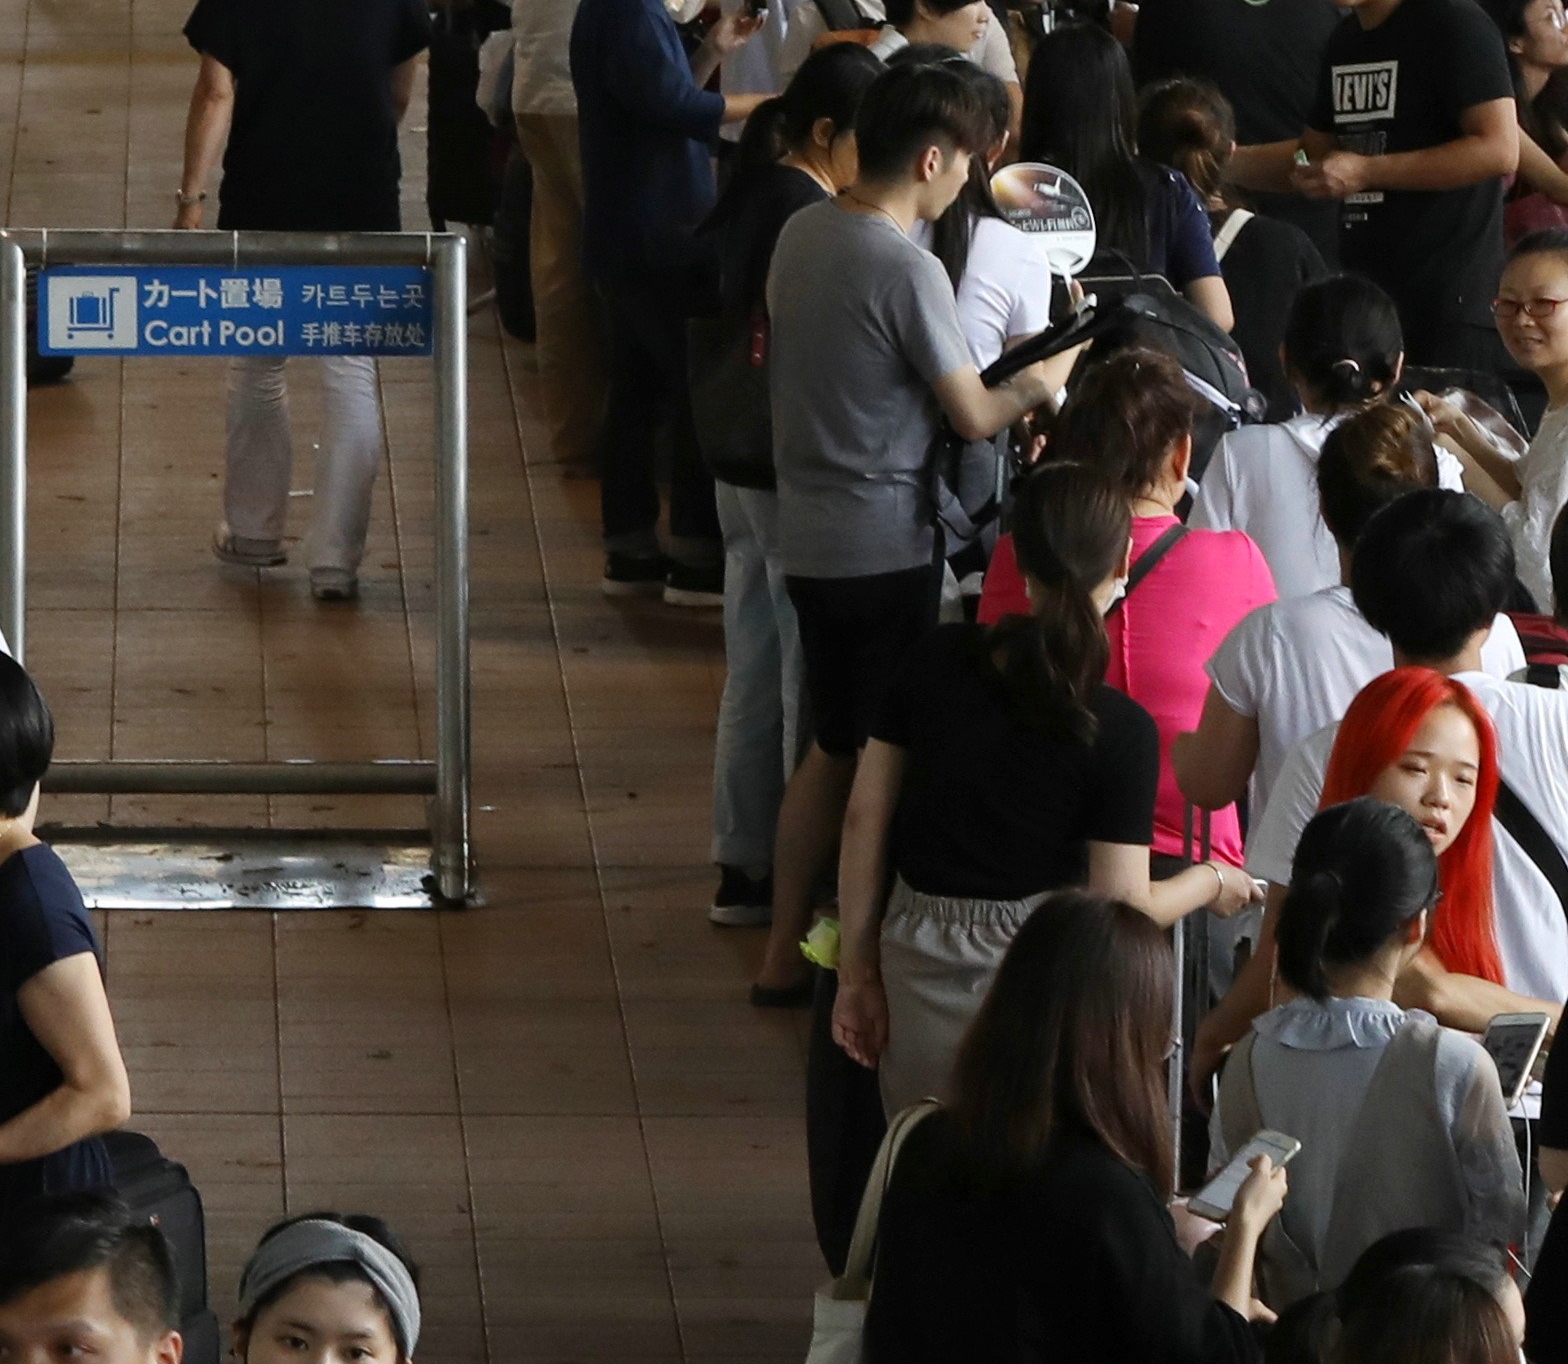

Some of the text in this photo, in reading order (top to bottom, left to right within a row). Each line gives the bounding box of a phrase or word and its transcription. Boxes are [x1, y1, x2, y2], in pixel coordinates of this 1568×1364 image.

[1332, 71, 1389, 113] LEVI'S
[143, 278, 283, 310] カート置場
[301, 283, 425, 310] 카트두는곳
[144, 320, 284, 348] Cart Pool
[300, 322, 426, 349] 手推车存放处
